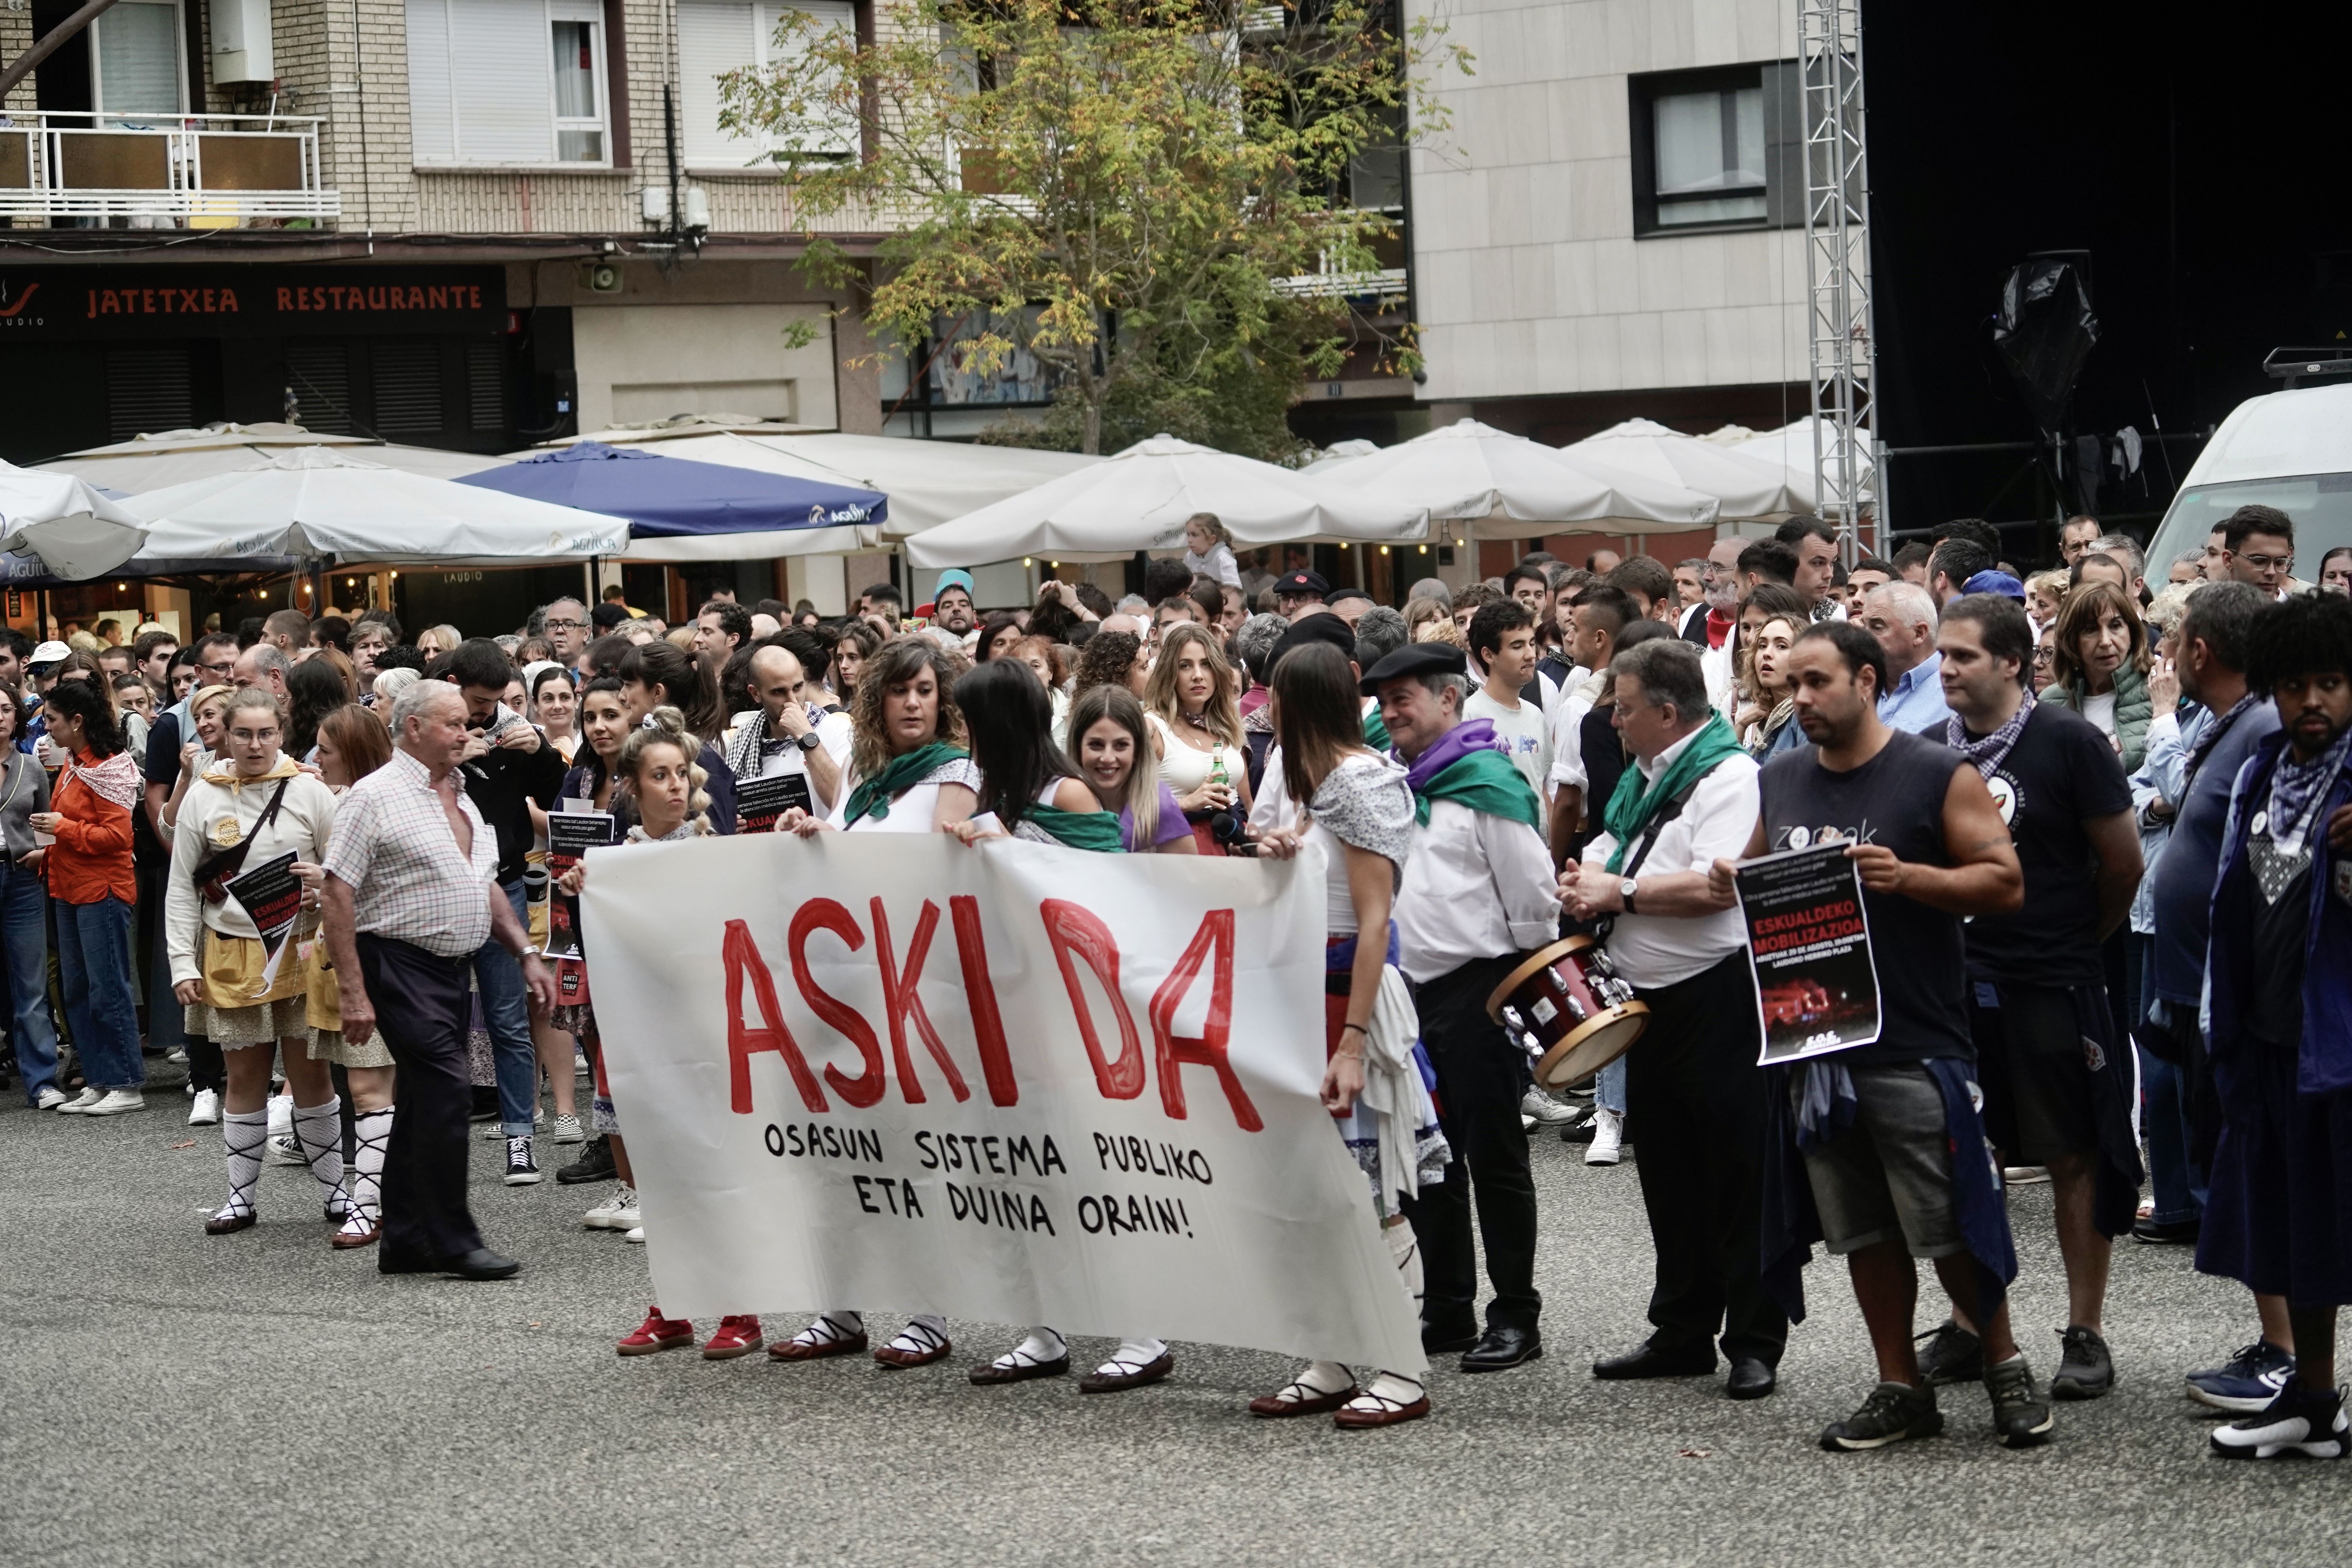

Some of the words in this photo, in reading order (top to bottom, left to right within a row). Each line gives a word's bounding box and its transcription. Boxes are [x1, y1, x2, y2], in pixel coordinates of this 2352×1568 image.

[88, 289, 238, 319] JATETXEA
[277, 286, 482, 311] RESTAURANTE
[0, 318, 44, 326] UDIO
[444, 571, 483, 583] LAUDIO
[1755, 900, 1855, 935] ESKUALDEKO
[1754, 917, 1864, 955] MOBILIZAZIOA
[722, 895, 1019, 1114] ASKI
[1040, 898, 1265, 1132] DA
[764, 1122, 883, 1163] OSASUN
[915, 1131, 1067, 1176] SISTEMA
[1093, 1132, 1213, 1185] PUBLIKO
[852, 1175, 924, 1219] ETA
[946, 1181, 1056, 1237] DUINA
[1078, 1194, 1194, 1239] ORAIN!
